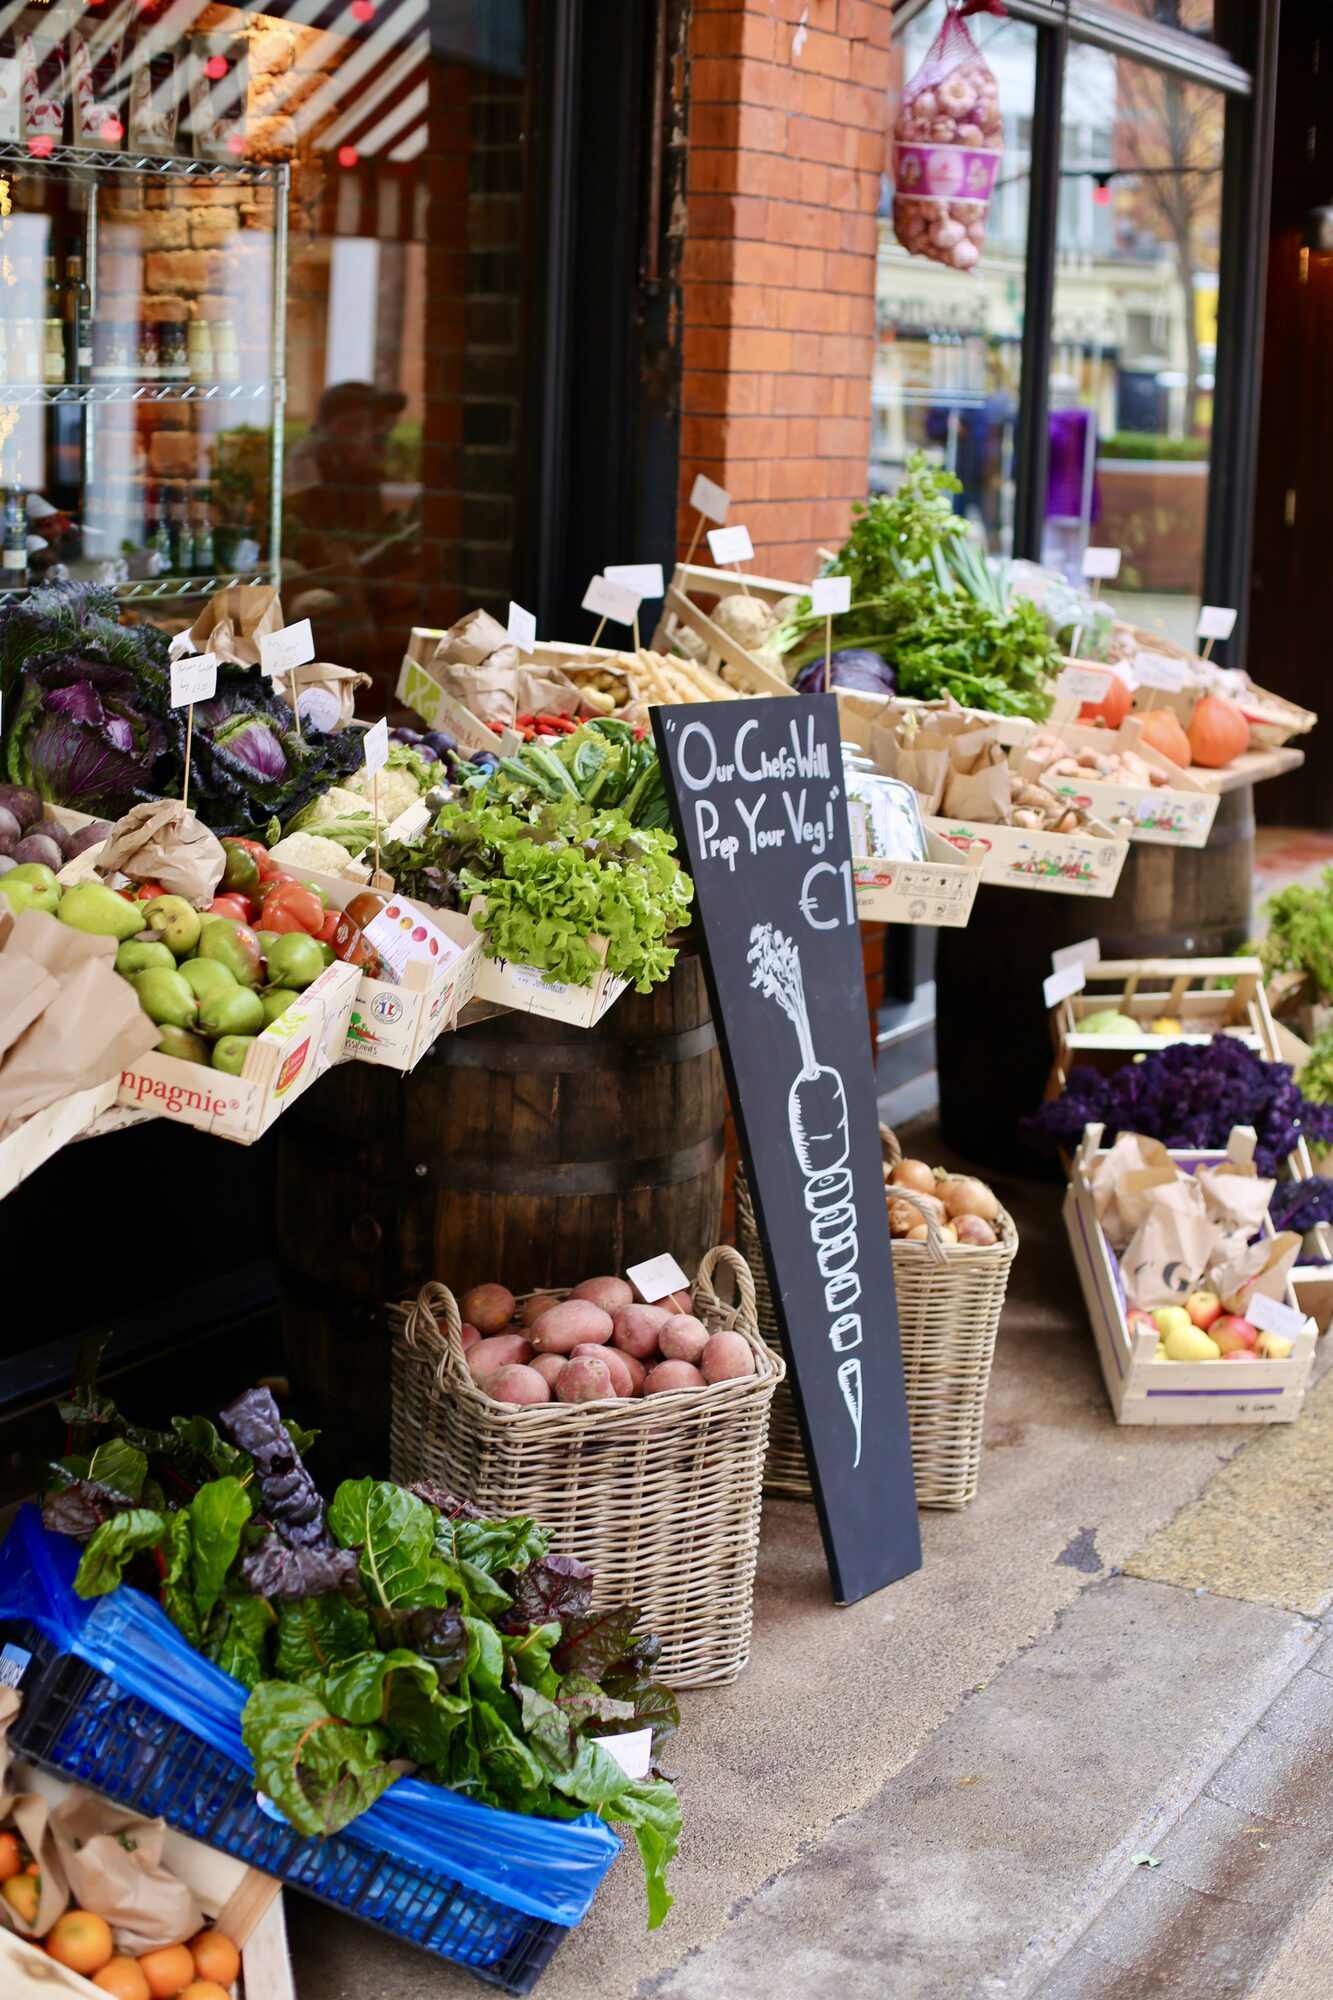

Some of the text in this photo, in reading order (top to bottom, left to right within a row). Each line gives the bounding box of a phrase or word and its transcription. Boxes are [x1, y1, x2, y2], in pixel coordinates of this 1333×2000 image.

[735, 719, 796, 781] Chefs
[789, 714, 830, 779] Will
[695, 799, 739, 872] Prep
[735, 793, 785, 855] Your
[799, 859, 855, 930] €1
